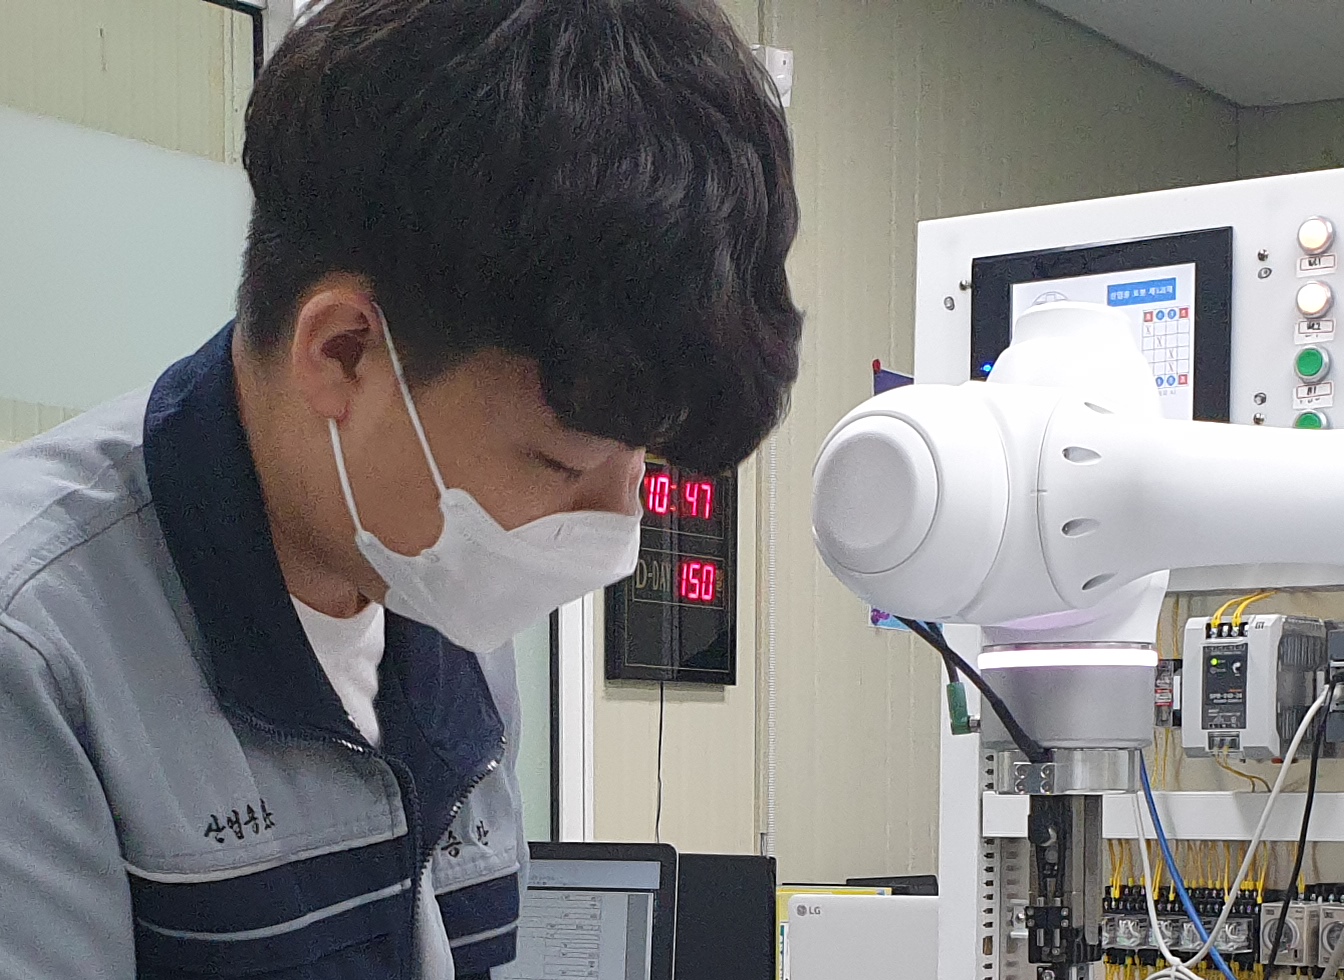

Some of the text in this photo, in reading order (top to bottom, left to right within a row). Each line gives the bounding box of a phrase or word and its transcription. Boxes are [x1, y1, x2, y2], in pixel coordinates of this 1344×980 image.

[646, 475, 712, 519] 10:47
[637, 559, 671, 591] D-DAY
[680, 563, 714, 601] 150
[808, 905, 821, 916] LG
